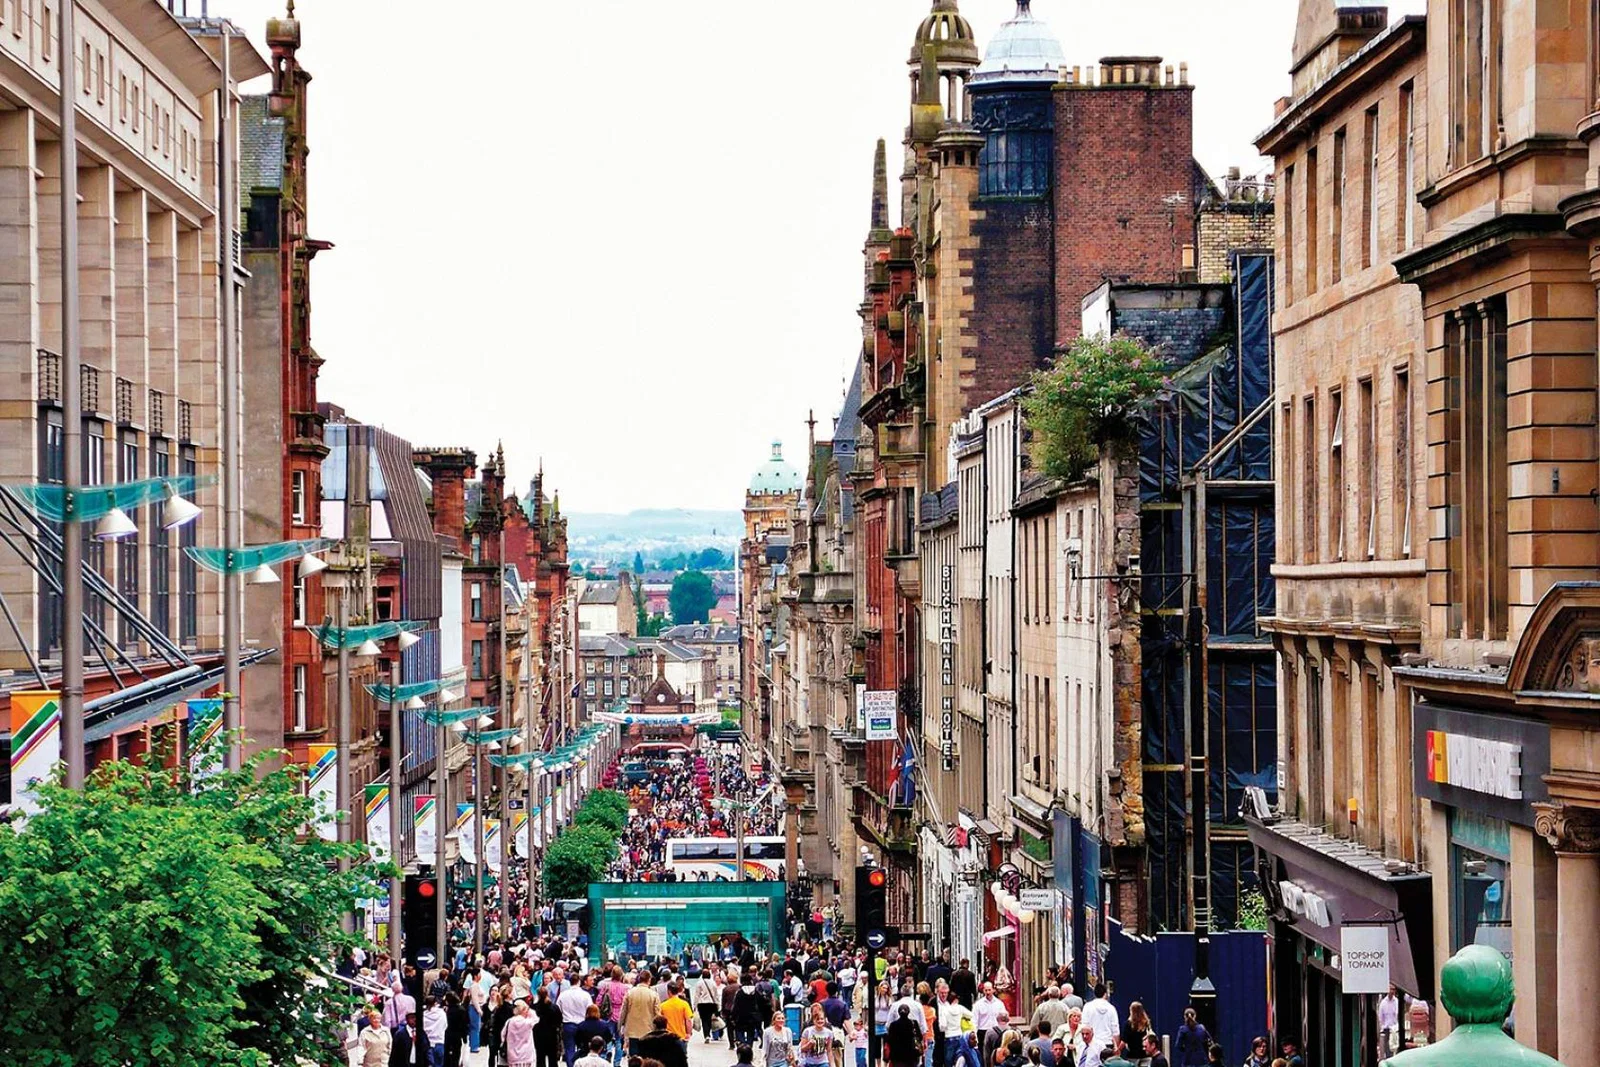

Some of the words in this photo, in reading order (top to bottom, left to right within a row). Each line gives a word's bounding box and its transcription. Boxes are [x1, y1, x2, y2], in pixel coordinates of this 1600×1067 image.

[942, 566, 951, 685] BUCHANAN
[942, 698, 951, 771] HOTEL
[623, 886, 696, 895] BUCHANAN
[700, 886, 752, 895] STREET
[1347, 951, 1385, 960] TOPSHOP
[1348, 961, 1384, 969] TOPMAN
